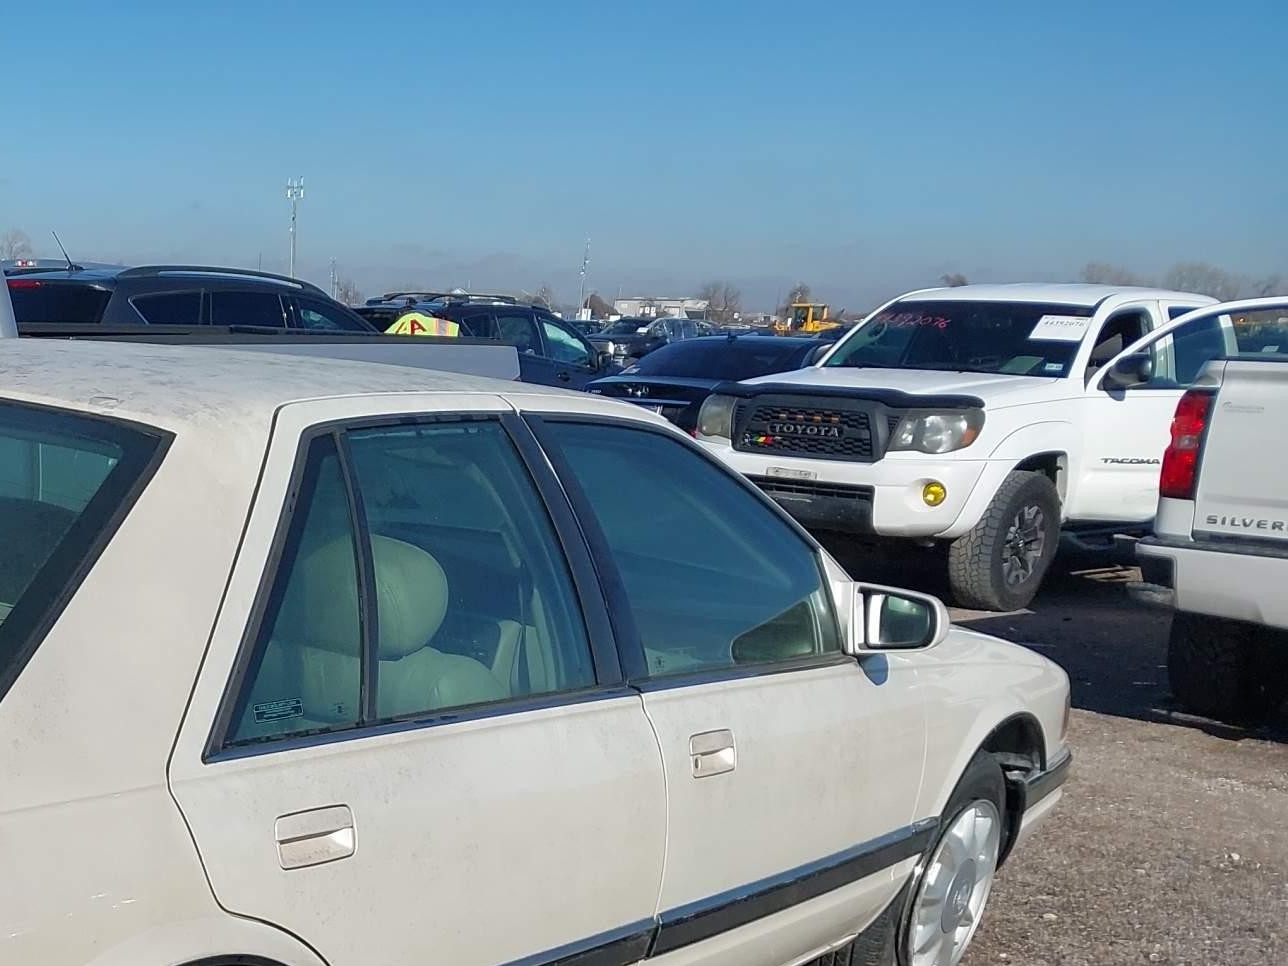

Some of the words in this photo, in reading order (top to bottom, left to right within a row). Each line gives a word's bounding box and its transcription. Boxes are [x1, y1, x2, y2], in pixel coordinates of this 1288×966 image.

[773, 423, 840, 438] TOYOTA
[1100, 457, 1161, 465] TACOMA
[1206, 514, 1288, 531] SILVER
